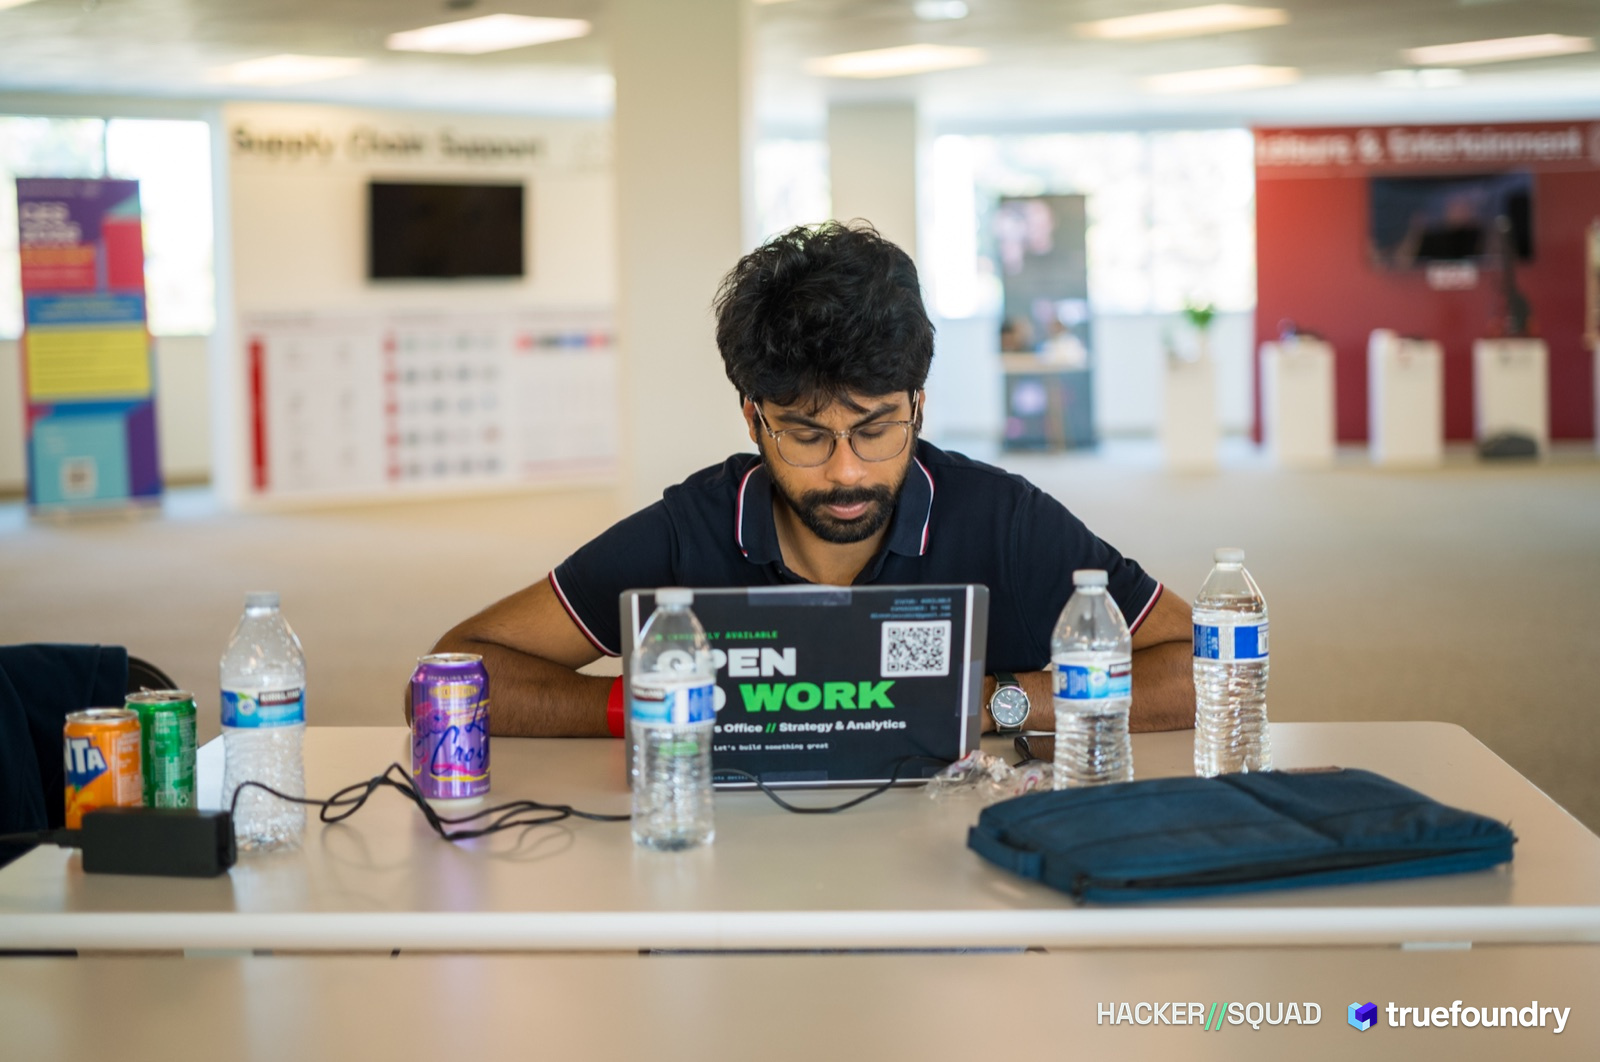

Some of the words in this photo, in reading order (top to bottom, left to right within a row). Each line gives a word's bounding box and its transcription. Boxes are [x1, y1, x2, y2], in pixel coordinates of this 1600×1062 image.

[234, 126, 333, 159] Supply
[1387, 127, 1583, 162] Entertainment
[725, 630, 778, 640] AVAILABLE
[738, 680, 896, 713] WORK
[723, 722, 763, 734] Office
[779, 720, 834, 735] Strategy
[835, 720, 845, 732] &
[846, 719, 907, 732] Analytics
[713, 744, 736, 752] Let's
[739, 743, 762, 752] build
[765, 742, 804, 753] something
[807, 742, 829, 752] great
